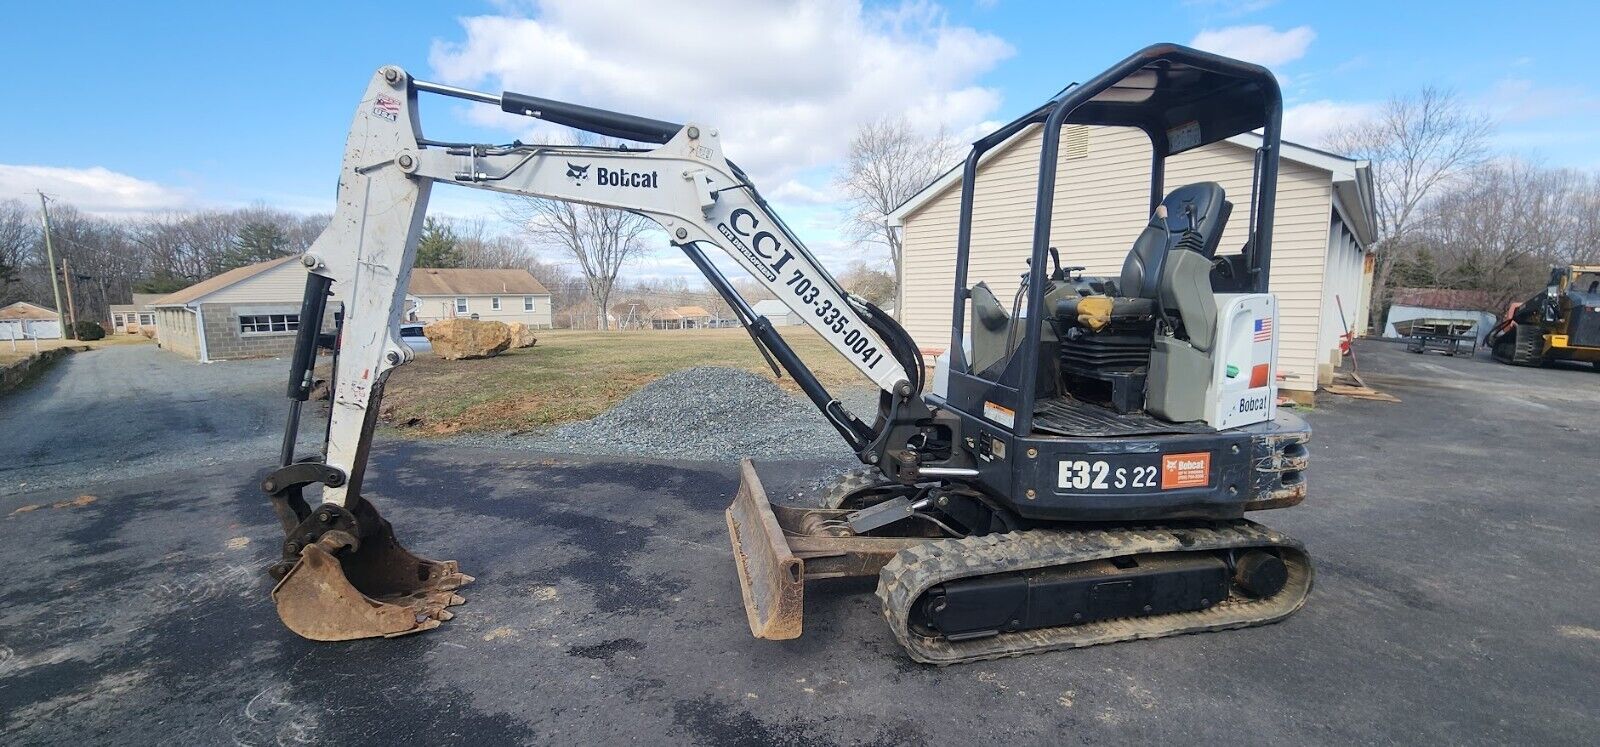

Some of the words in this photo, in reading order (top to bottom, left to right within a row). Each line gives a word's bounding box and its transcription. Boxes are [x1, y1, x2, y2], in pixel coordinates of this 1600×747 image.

[597, 167, 658, 188] Bobcat
[719, 225, 735, 241] SITE
[732, 238, 775, 281] DEVELOPMENT
[730, 208, 795, 274] CCI
[786, 269, 883, 370] 703-335-0041
[1239, 395, 1267, 413] Bobcat
[1058, 461, 1110, 489] E32
[1132, 466, 1157, 487] 22
[1178, 460, 1204, 470] Bobcat
